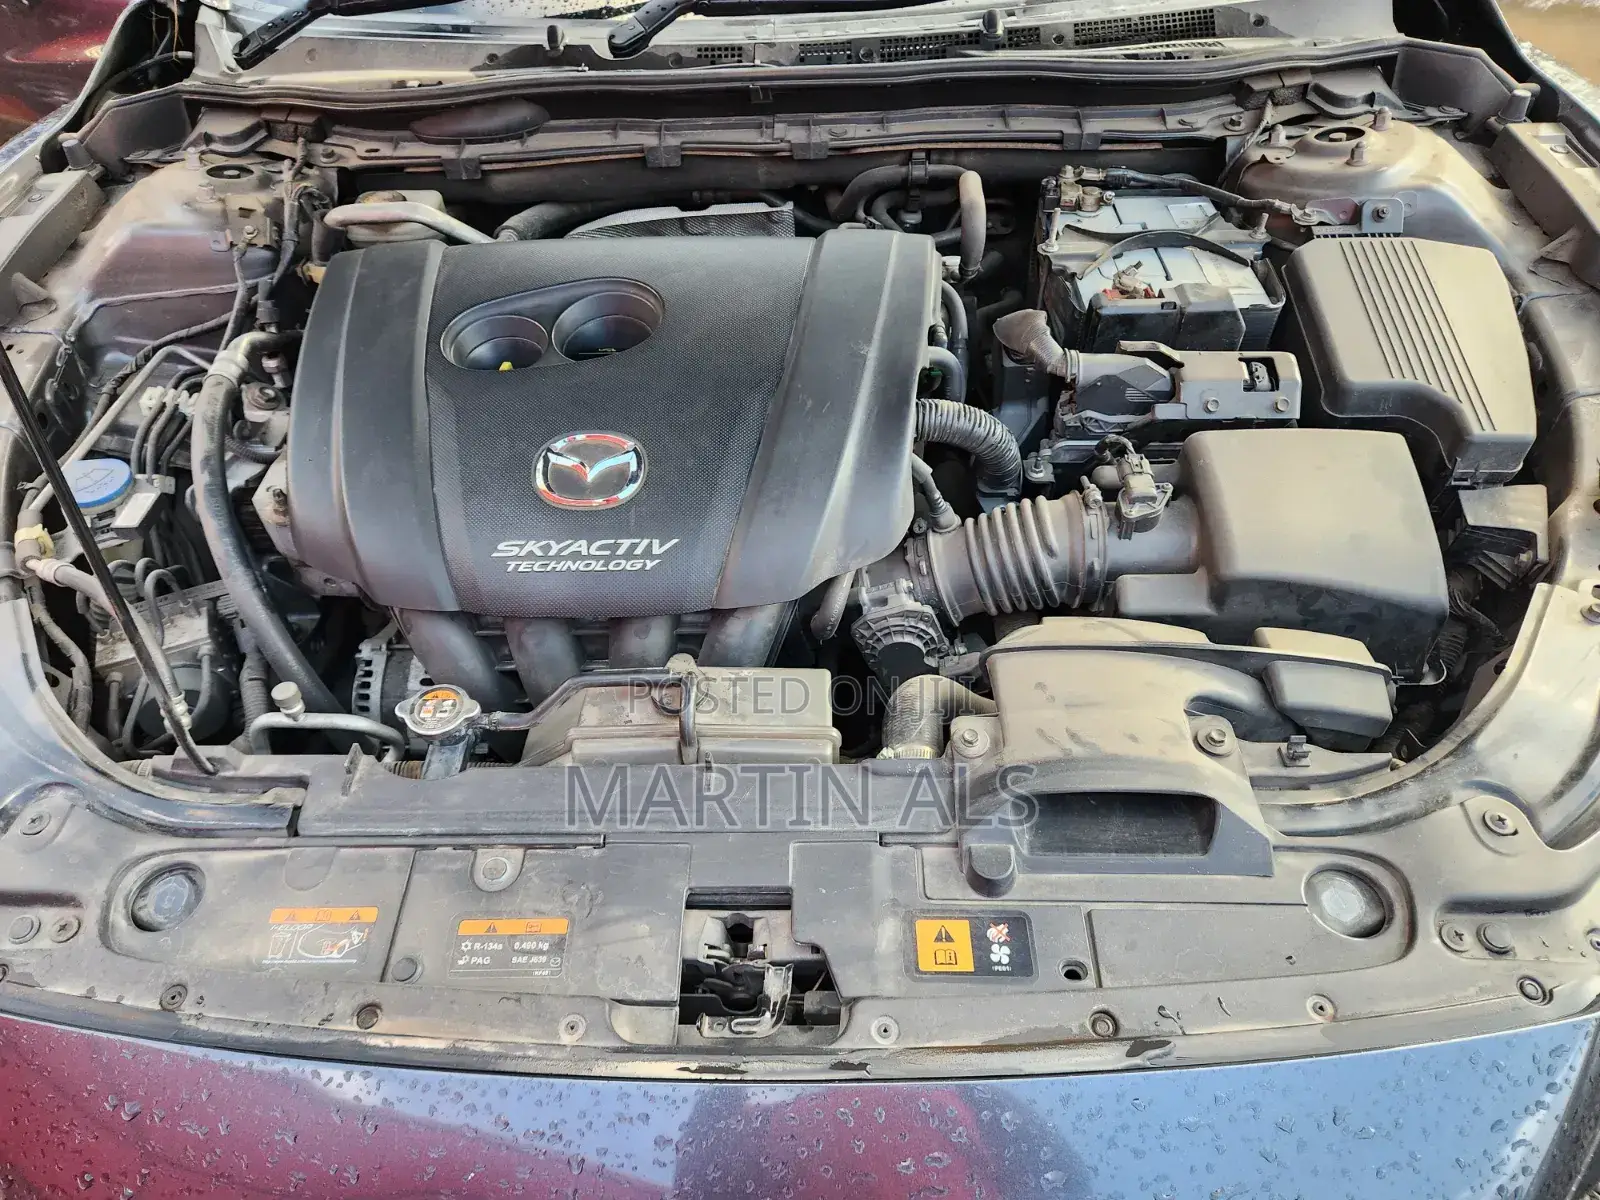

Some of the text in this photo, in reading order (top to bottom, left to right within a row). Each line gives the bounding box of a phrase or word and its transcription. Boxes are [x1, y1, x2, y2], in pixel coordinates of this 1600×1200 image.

[490, 538, 681, 557] SKYACTIV
[505, 559, 662, 573] TECHNOLOGY
[538, 941, 550, 951] kg
[470, 956, 491, 965] PAG
[511, 956, 528, 964] SAE
